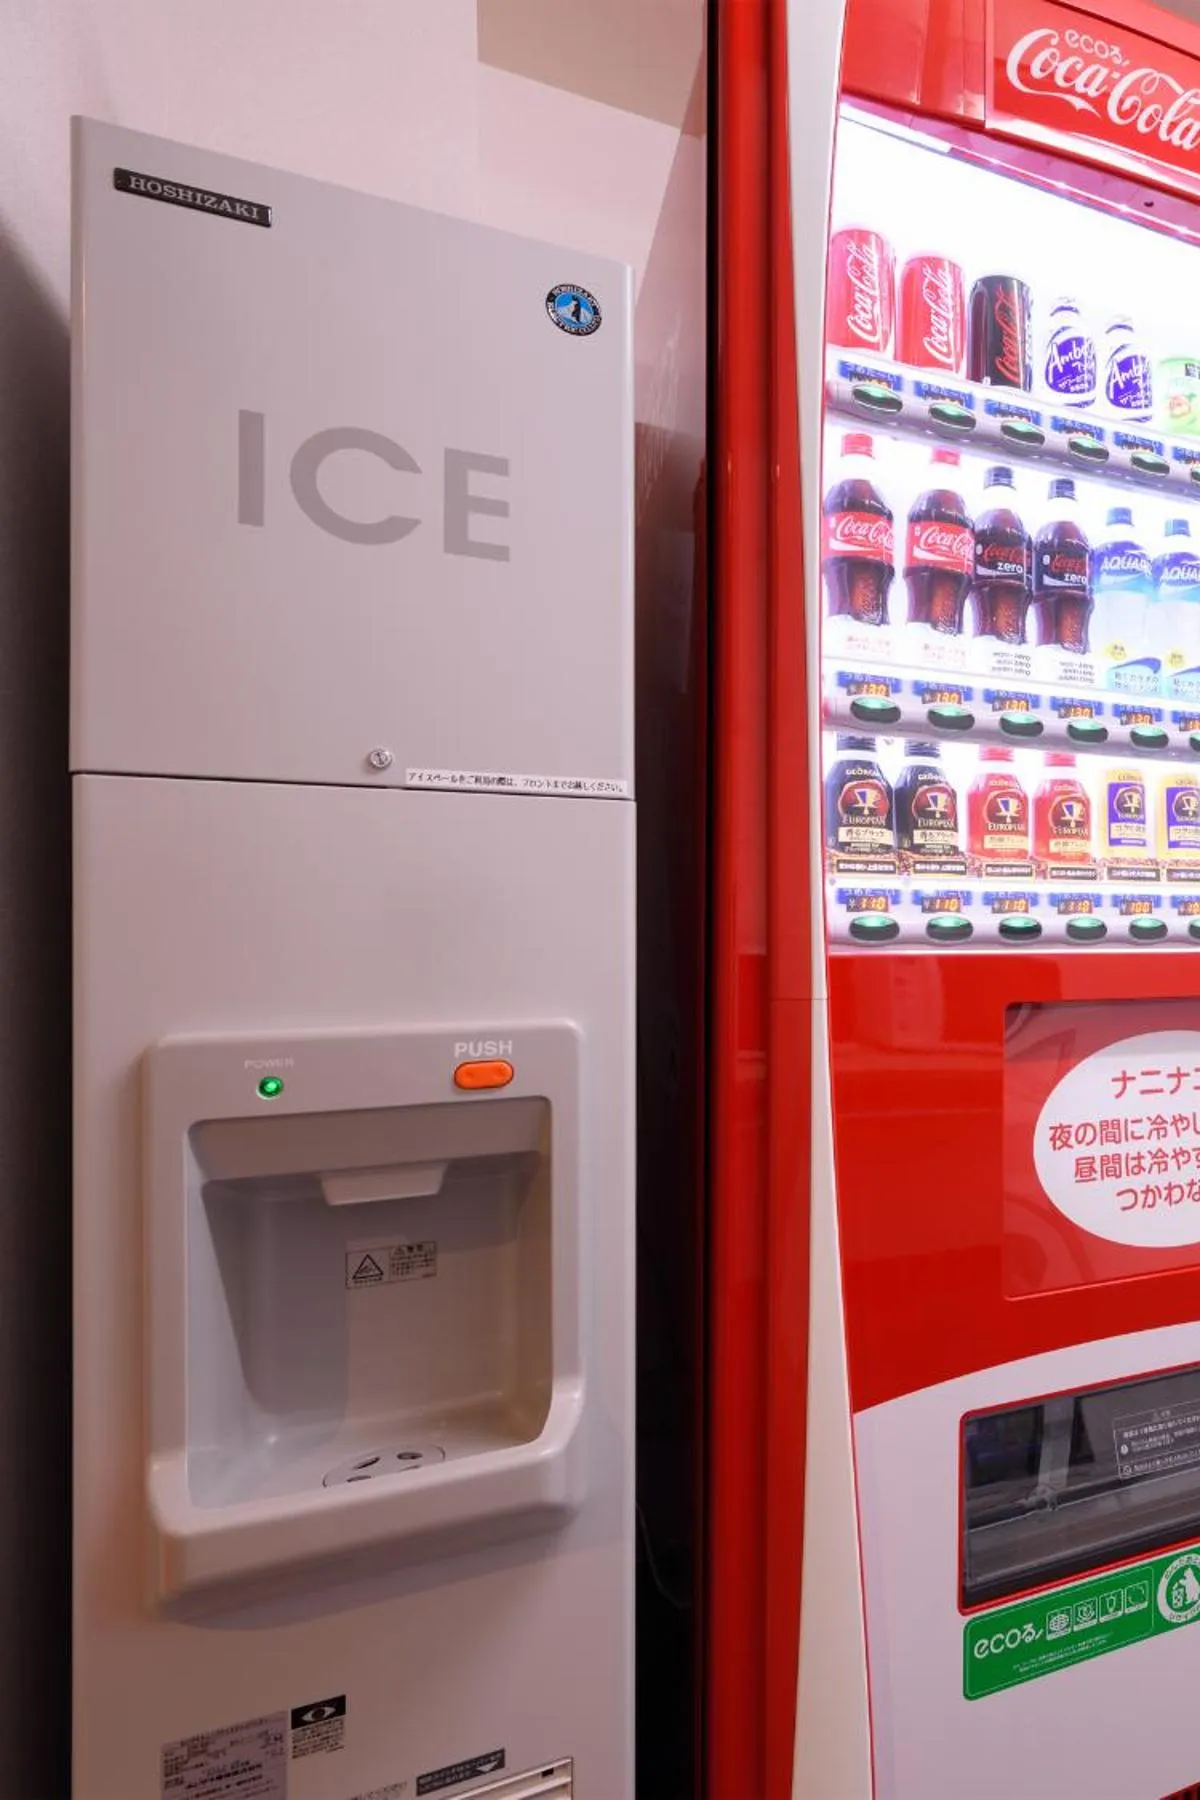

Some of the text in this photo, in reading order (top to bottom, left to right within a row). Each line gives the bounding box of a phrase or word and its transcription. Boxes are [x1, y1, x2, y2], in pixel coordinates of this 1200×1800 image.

[129, 175, 260, 219] HOSHIZAKI
[237, 409, 511, 563] ICE
[997, 561, 1023, 574] zero
[1064, 573, 1086, 584] zero
[935, 898, 958, 911] 110
[454, 1040, 513, 1057] PUSH
[244, 1057, 294, 1070] POWER
